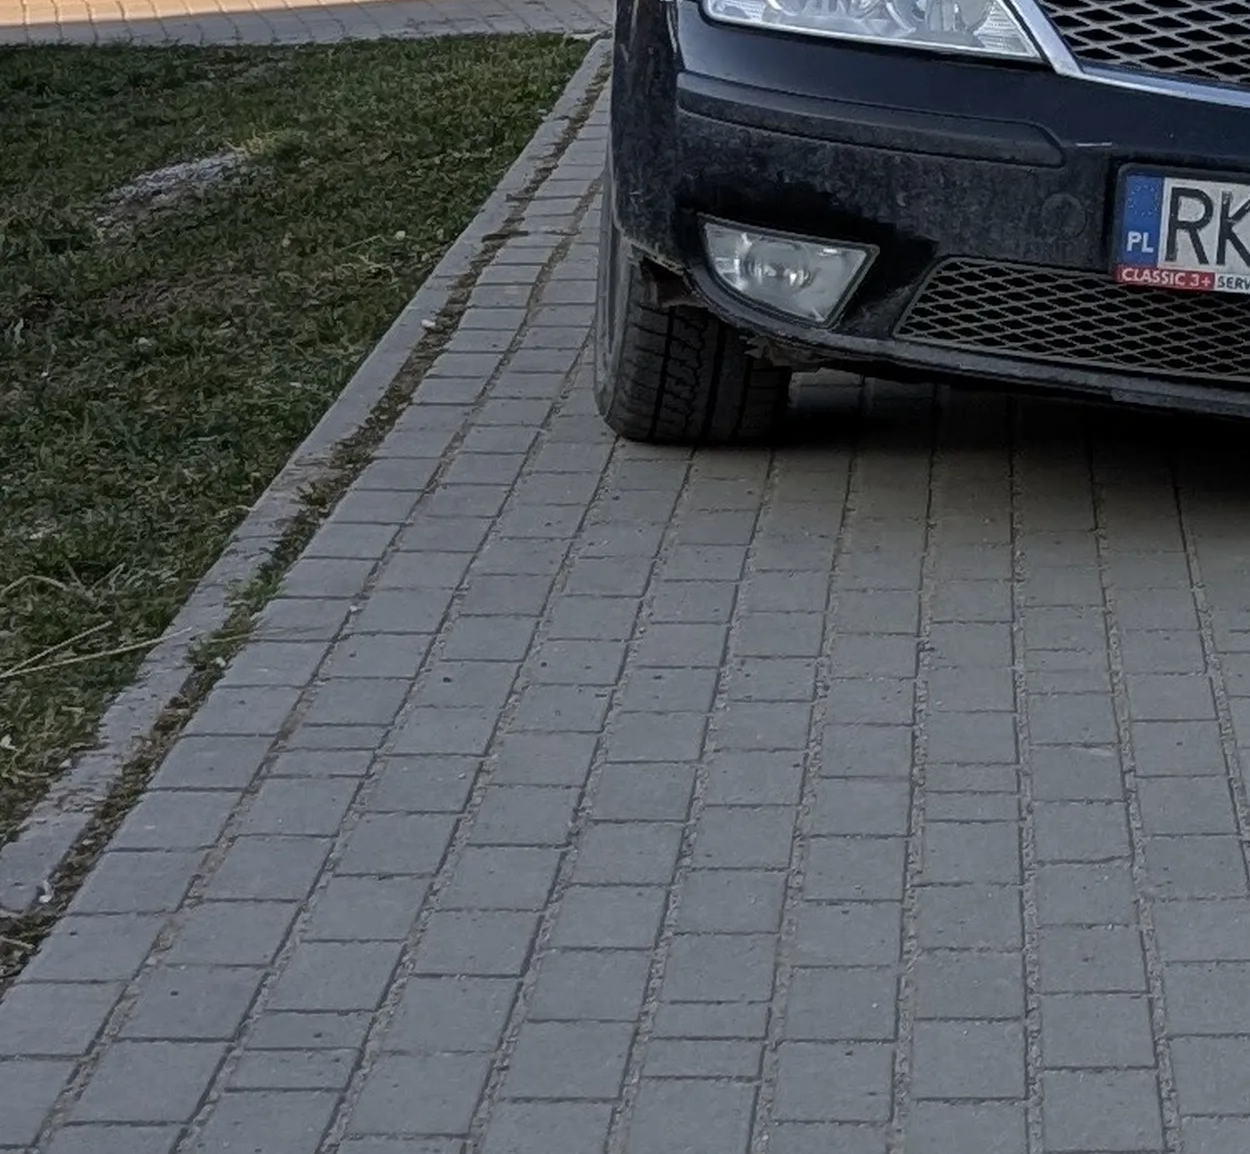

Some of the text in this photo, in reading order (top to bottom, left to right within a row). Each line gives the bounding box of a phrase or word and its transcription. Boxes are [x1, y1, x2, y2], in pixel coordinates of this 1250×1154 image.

[1126, 230, 1154, 253] PL
[1121, 267, 1212, 288] CLASSIC 3+
